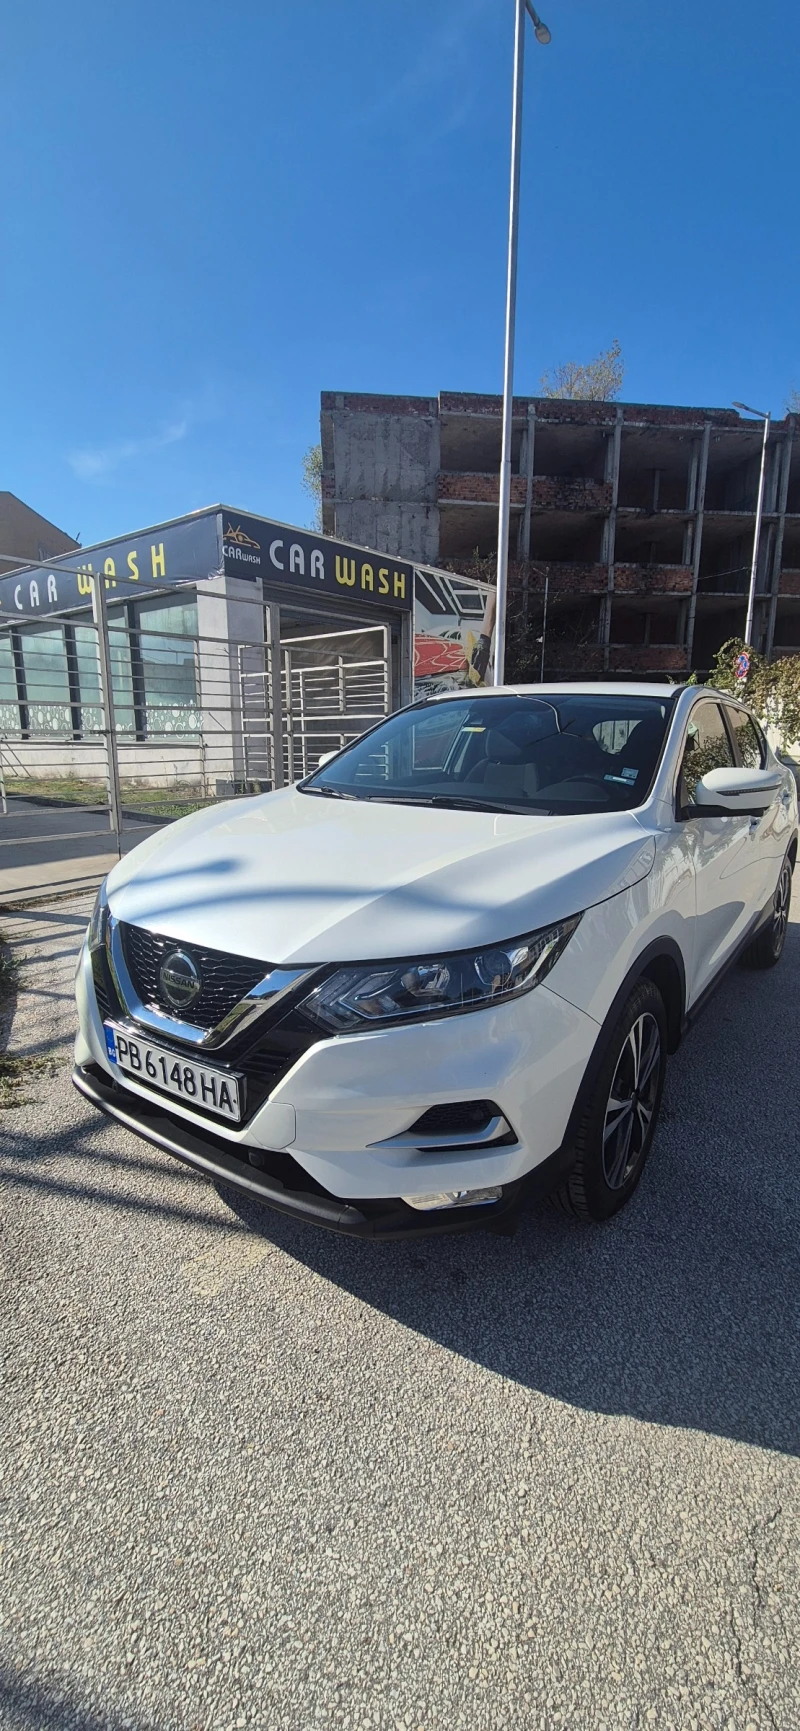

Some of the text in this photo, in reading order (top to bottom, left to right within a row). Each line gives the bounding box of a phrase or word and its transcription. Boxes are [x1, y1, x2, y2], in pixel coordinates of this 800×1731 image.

[14, 543, 166, 610] CAR WASH
[269, 539, 406, 599] CAR WASH
[163, 972, 195, 989] NISSAN
